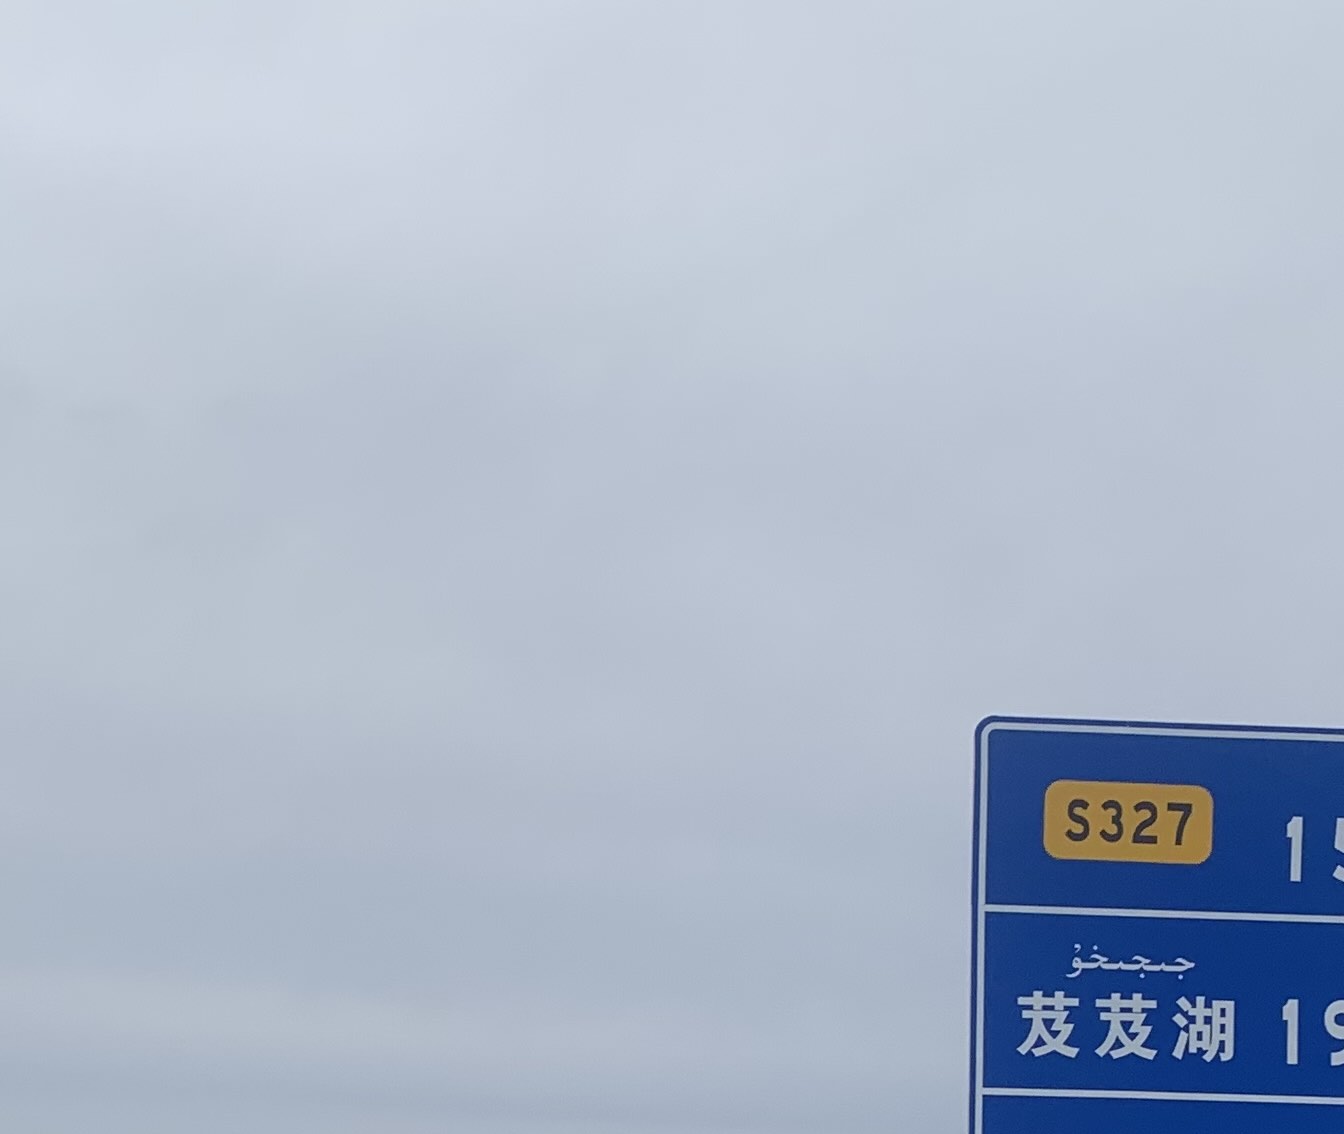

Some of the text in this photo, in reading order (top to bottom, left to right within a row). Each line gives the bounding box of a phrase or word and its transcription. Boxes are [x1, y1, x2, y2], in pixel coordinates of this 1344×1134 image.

[1065, 799, 1194, 846] S327
[1016, 990, 1236, 1063] 芨芨湖
